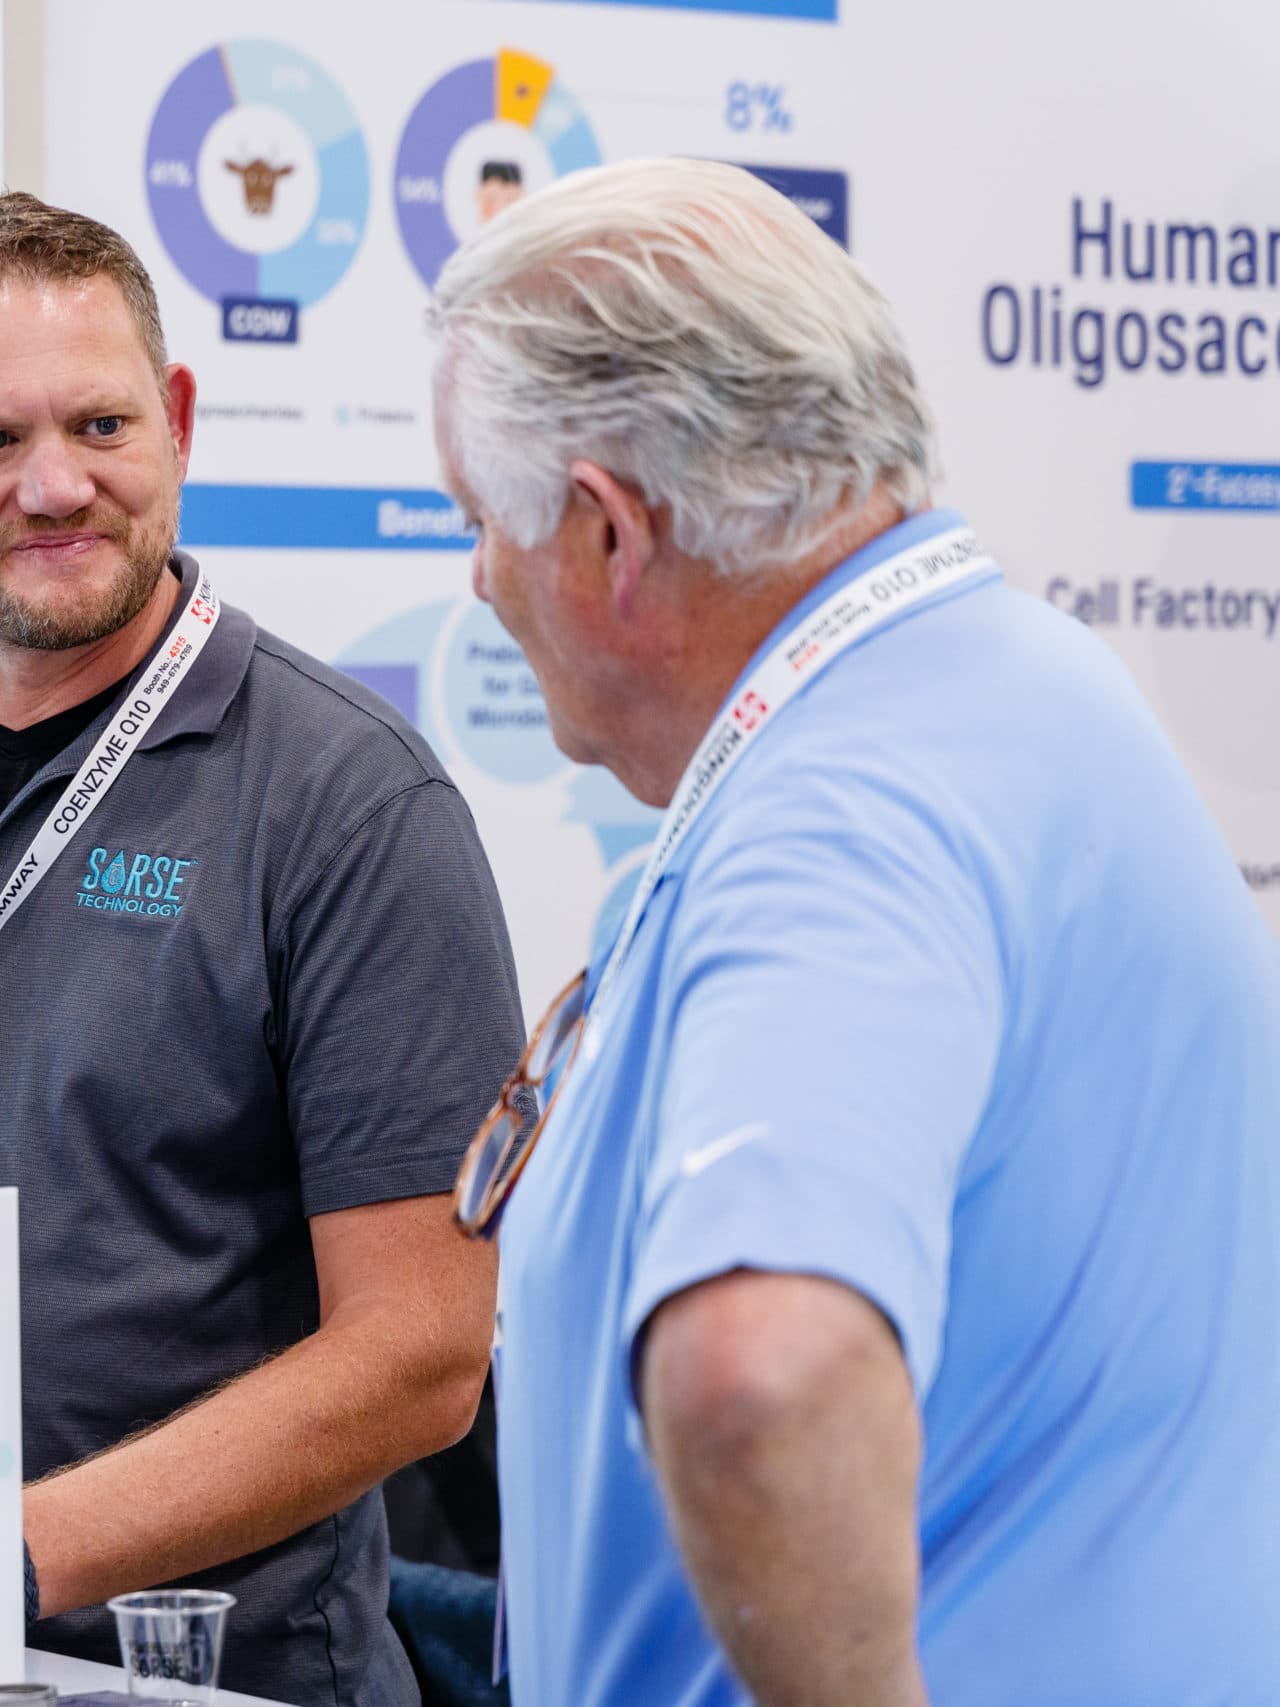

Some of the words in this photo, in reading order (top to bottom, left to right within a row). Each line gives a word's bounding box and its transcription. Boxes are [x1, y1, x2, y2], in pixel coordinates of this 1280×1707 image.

[726, 79, 792, 132] 8%
[229, 305, 292, 337] COW
[981, 284, 1280, 388] Oligosac
[1045, 574, 1121, 626] Cell
[1132, 578, 1280, 641] Factory
[143, 672, 162, 695] Booth
[168, 636, 188, 658] 4315
[53, 734, 129, 836] COENZYME
[120, 698, 152, 738] Q10
[76, 892, 183, 919] TECHNOLOGY
